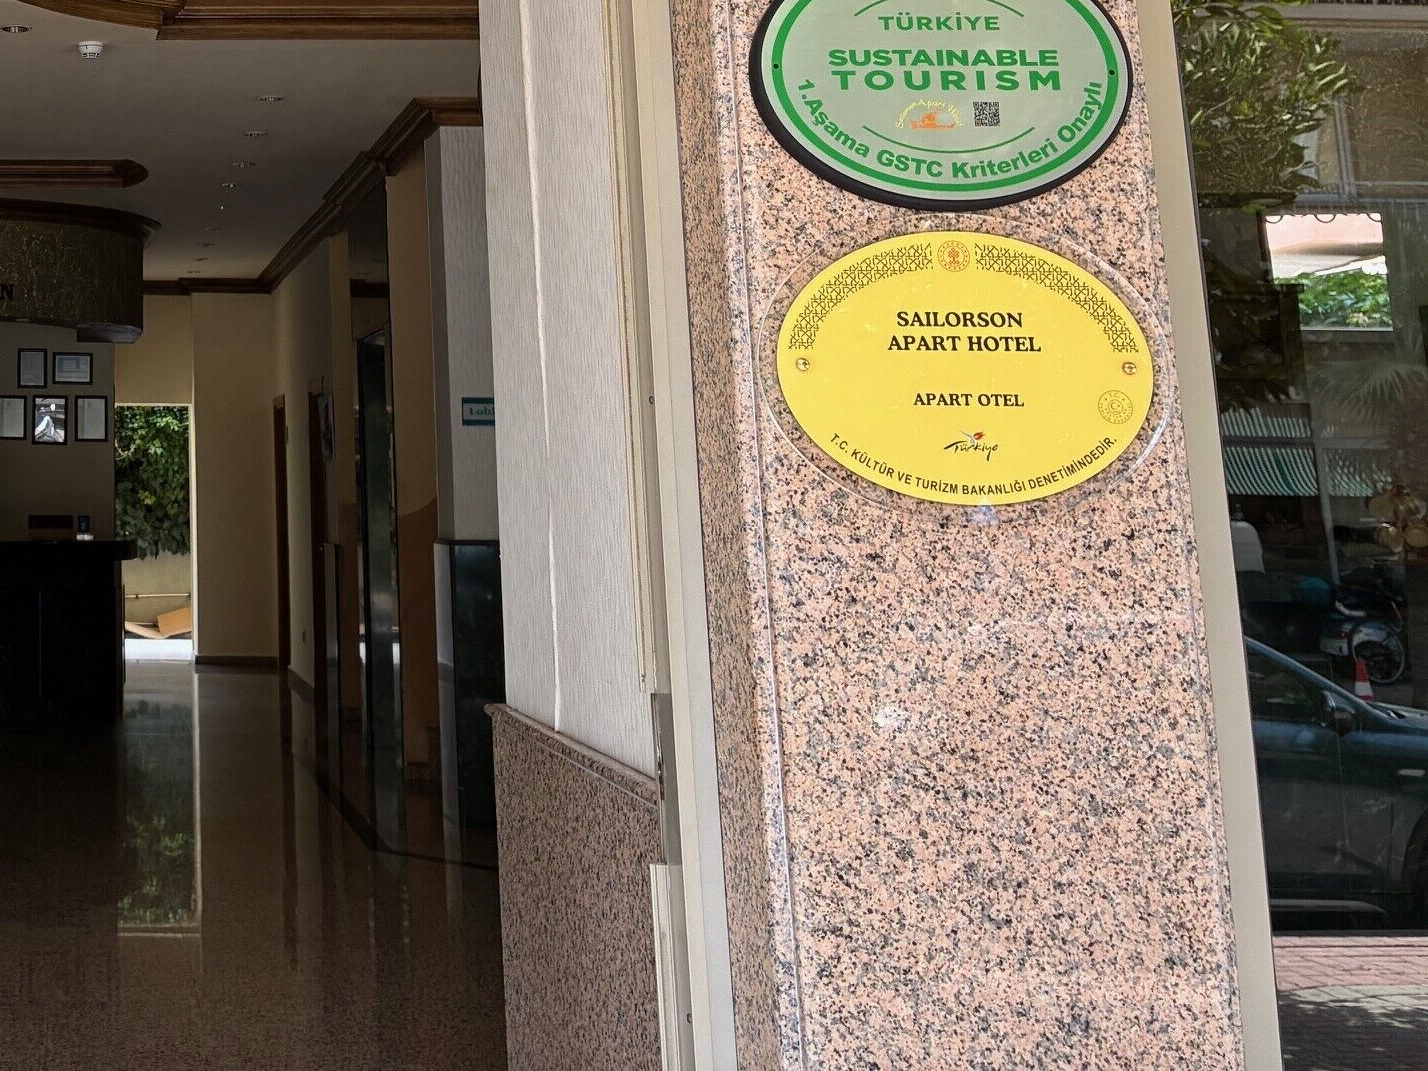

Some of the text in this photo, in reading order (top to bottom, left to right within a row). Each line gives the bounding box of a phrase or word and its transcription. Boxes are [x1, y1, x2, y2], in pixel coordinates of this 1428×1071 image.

[877, 11, 1000, 31] TÜRKİYE
[828, 49, 1060, 66] SUSTAINABLE
[831, 70, 1061, 91] TOURISM
[876, 149, 943, 178] GSTC
[951, 138, 1059, 178] Kriterleri
[1057, 81, 1103, 143] Onaylı
[896, 311, 1023, 328] SAILORSON
[887, 335, 1042, 352] APART HOTEL
[913, 393, 1025, 407] APART OTEL
[943, 439, 999, 462] Türkiye
[829, 432, 849, 453] T.C.
[850, 448, 895, 478] KÜLTÜR
[897, 470, 913, 485] VE
[914, 476, 958, 494] TURİZM
[961, 479, 1026, 496] BAKANLIĞI
